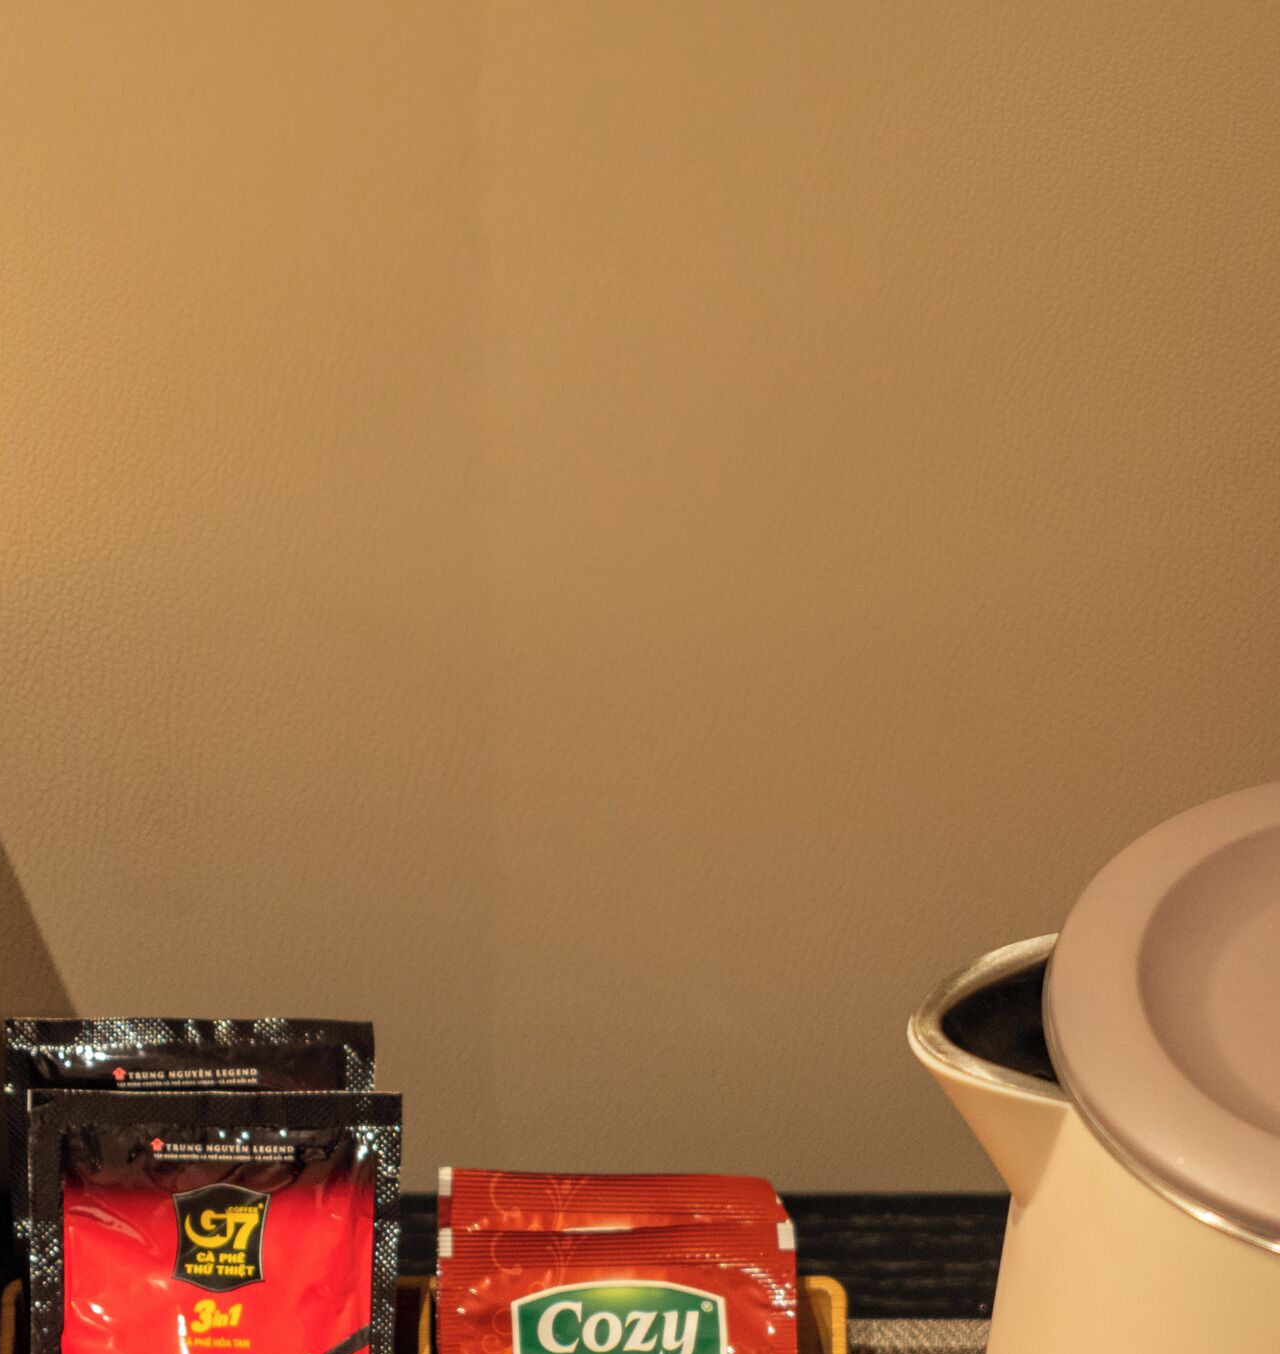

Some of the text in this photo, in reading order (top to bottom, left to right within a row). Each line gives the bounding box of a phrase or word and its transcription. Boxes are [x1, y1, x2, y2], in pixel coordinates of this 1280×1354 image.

[128, 1067, 258, 1080] TRUNG NGUYÊN LEGEND
[165, 1142, 295, 1154] TRUNG NGUYÊN LEGEND
[184, 1209, 260, 1251] G7
[196, 1250, 246, 1265] CÀ PHÊ
[190, 1298, 243, 1333] 3in1
